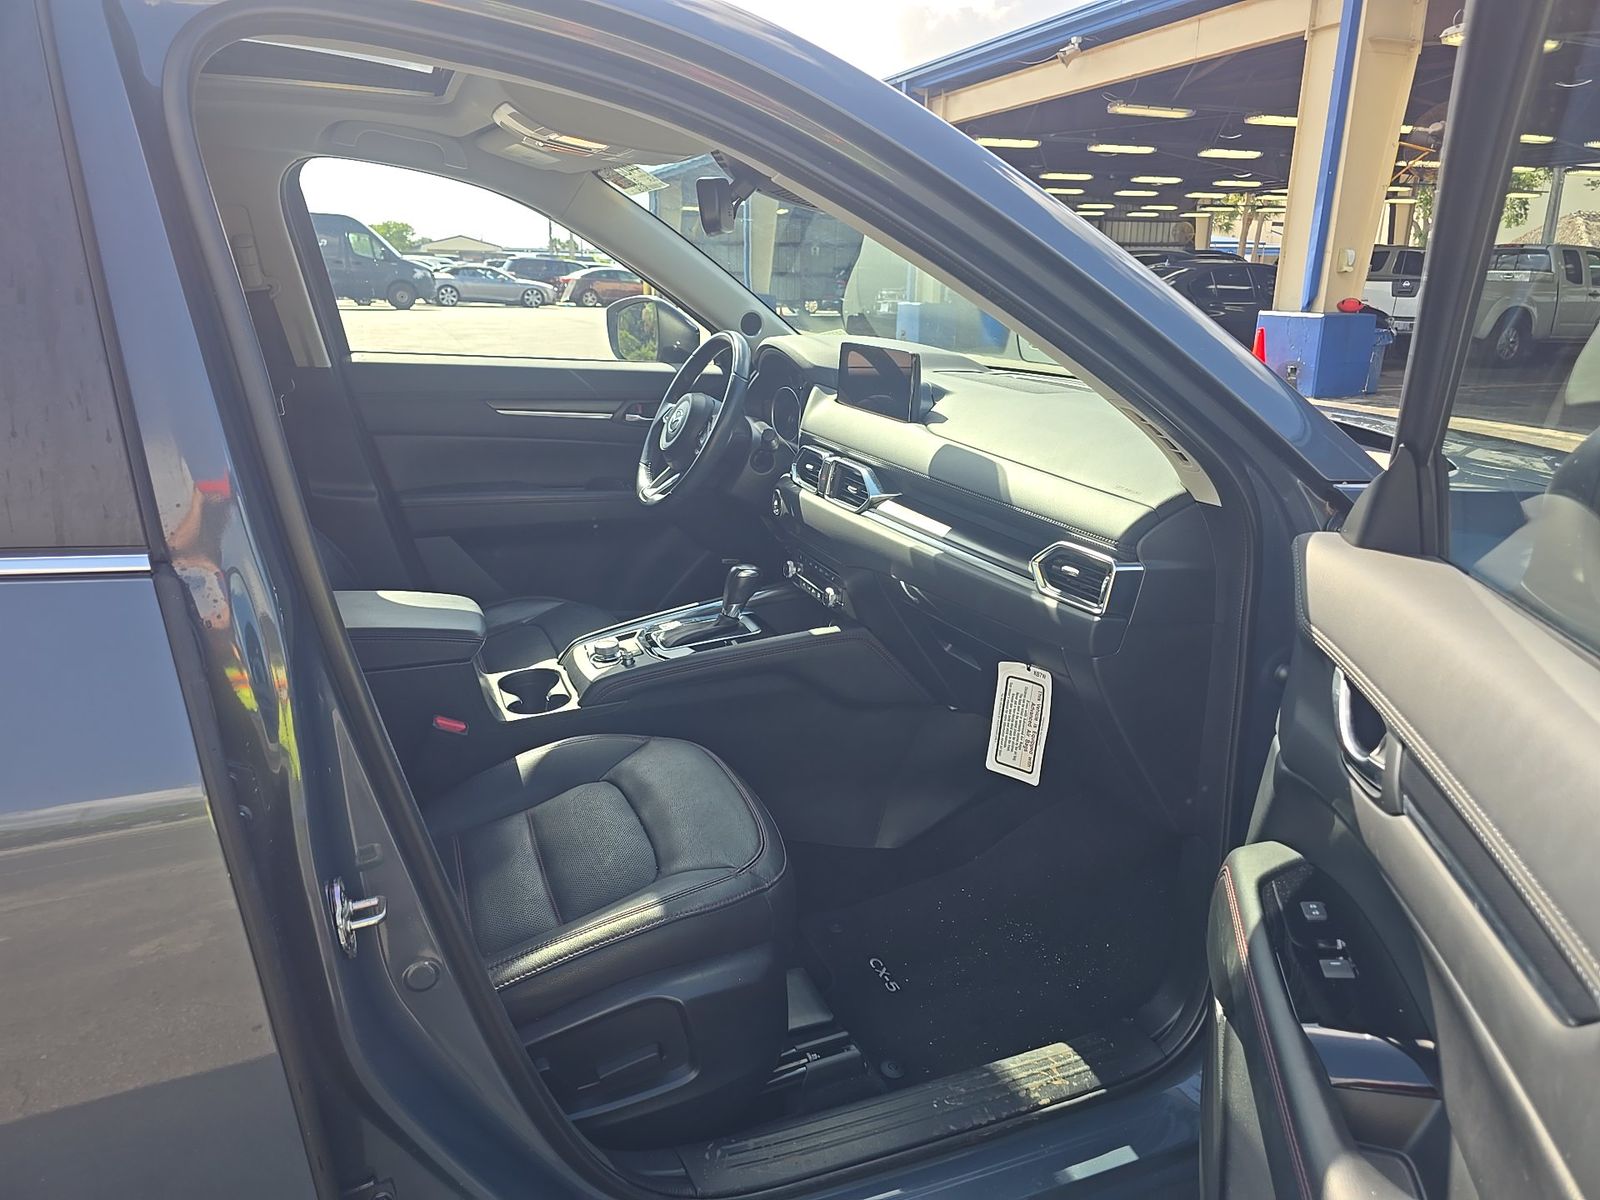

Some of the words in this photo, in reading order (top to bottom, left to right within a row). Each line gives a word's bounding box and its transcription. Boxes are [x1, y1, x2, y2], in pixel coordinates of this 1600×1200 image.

[1027, 701, 1035, 727] Advanced
[1022, 738, 1030, 752] Bags
[1028, 730, 1036, 754] Equipped
[869, 958, 901, 992] CX-5
